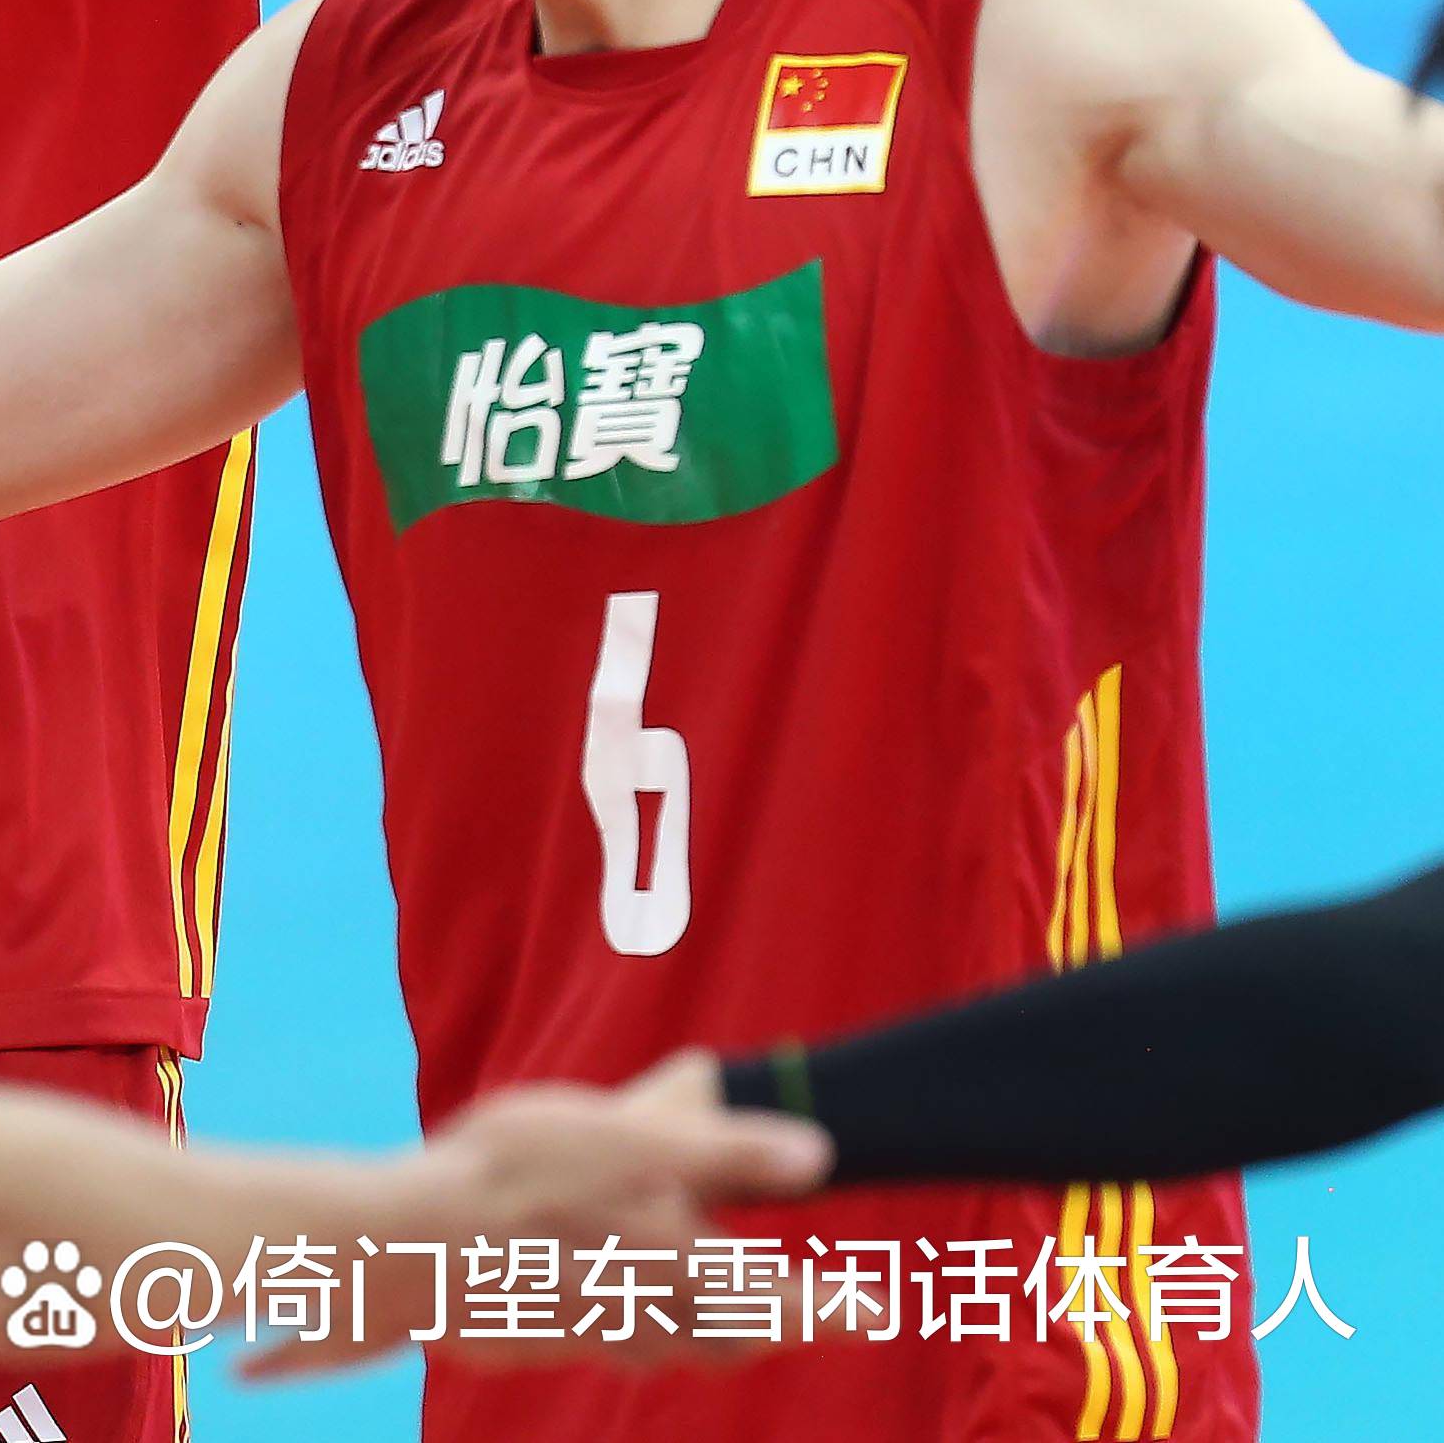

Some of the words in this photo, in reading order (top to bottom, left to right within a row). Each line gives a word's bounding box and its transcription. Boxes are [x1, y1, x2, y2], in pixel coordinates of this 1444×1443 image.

[773, 145, 869, 178] CHN
[440, 321, 706, 488] 怡寶
[583, 590, 692, 957] 6
